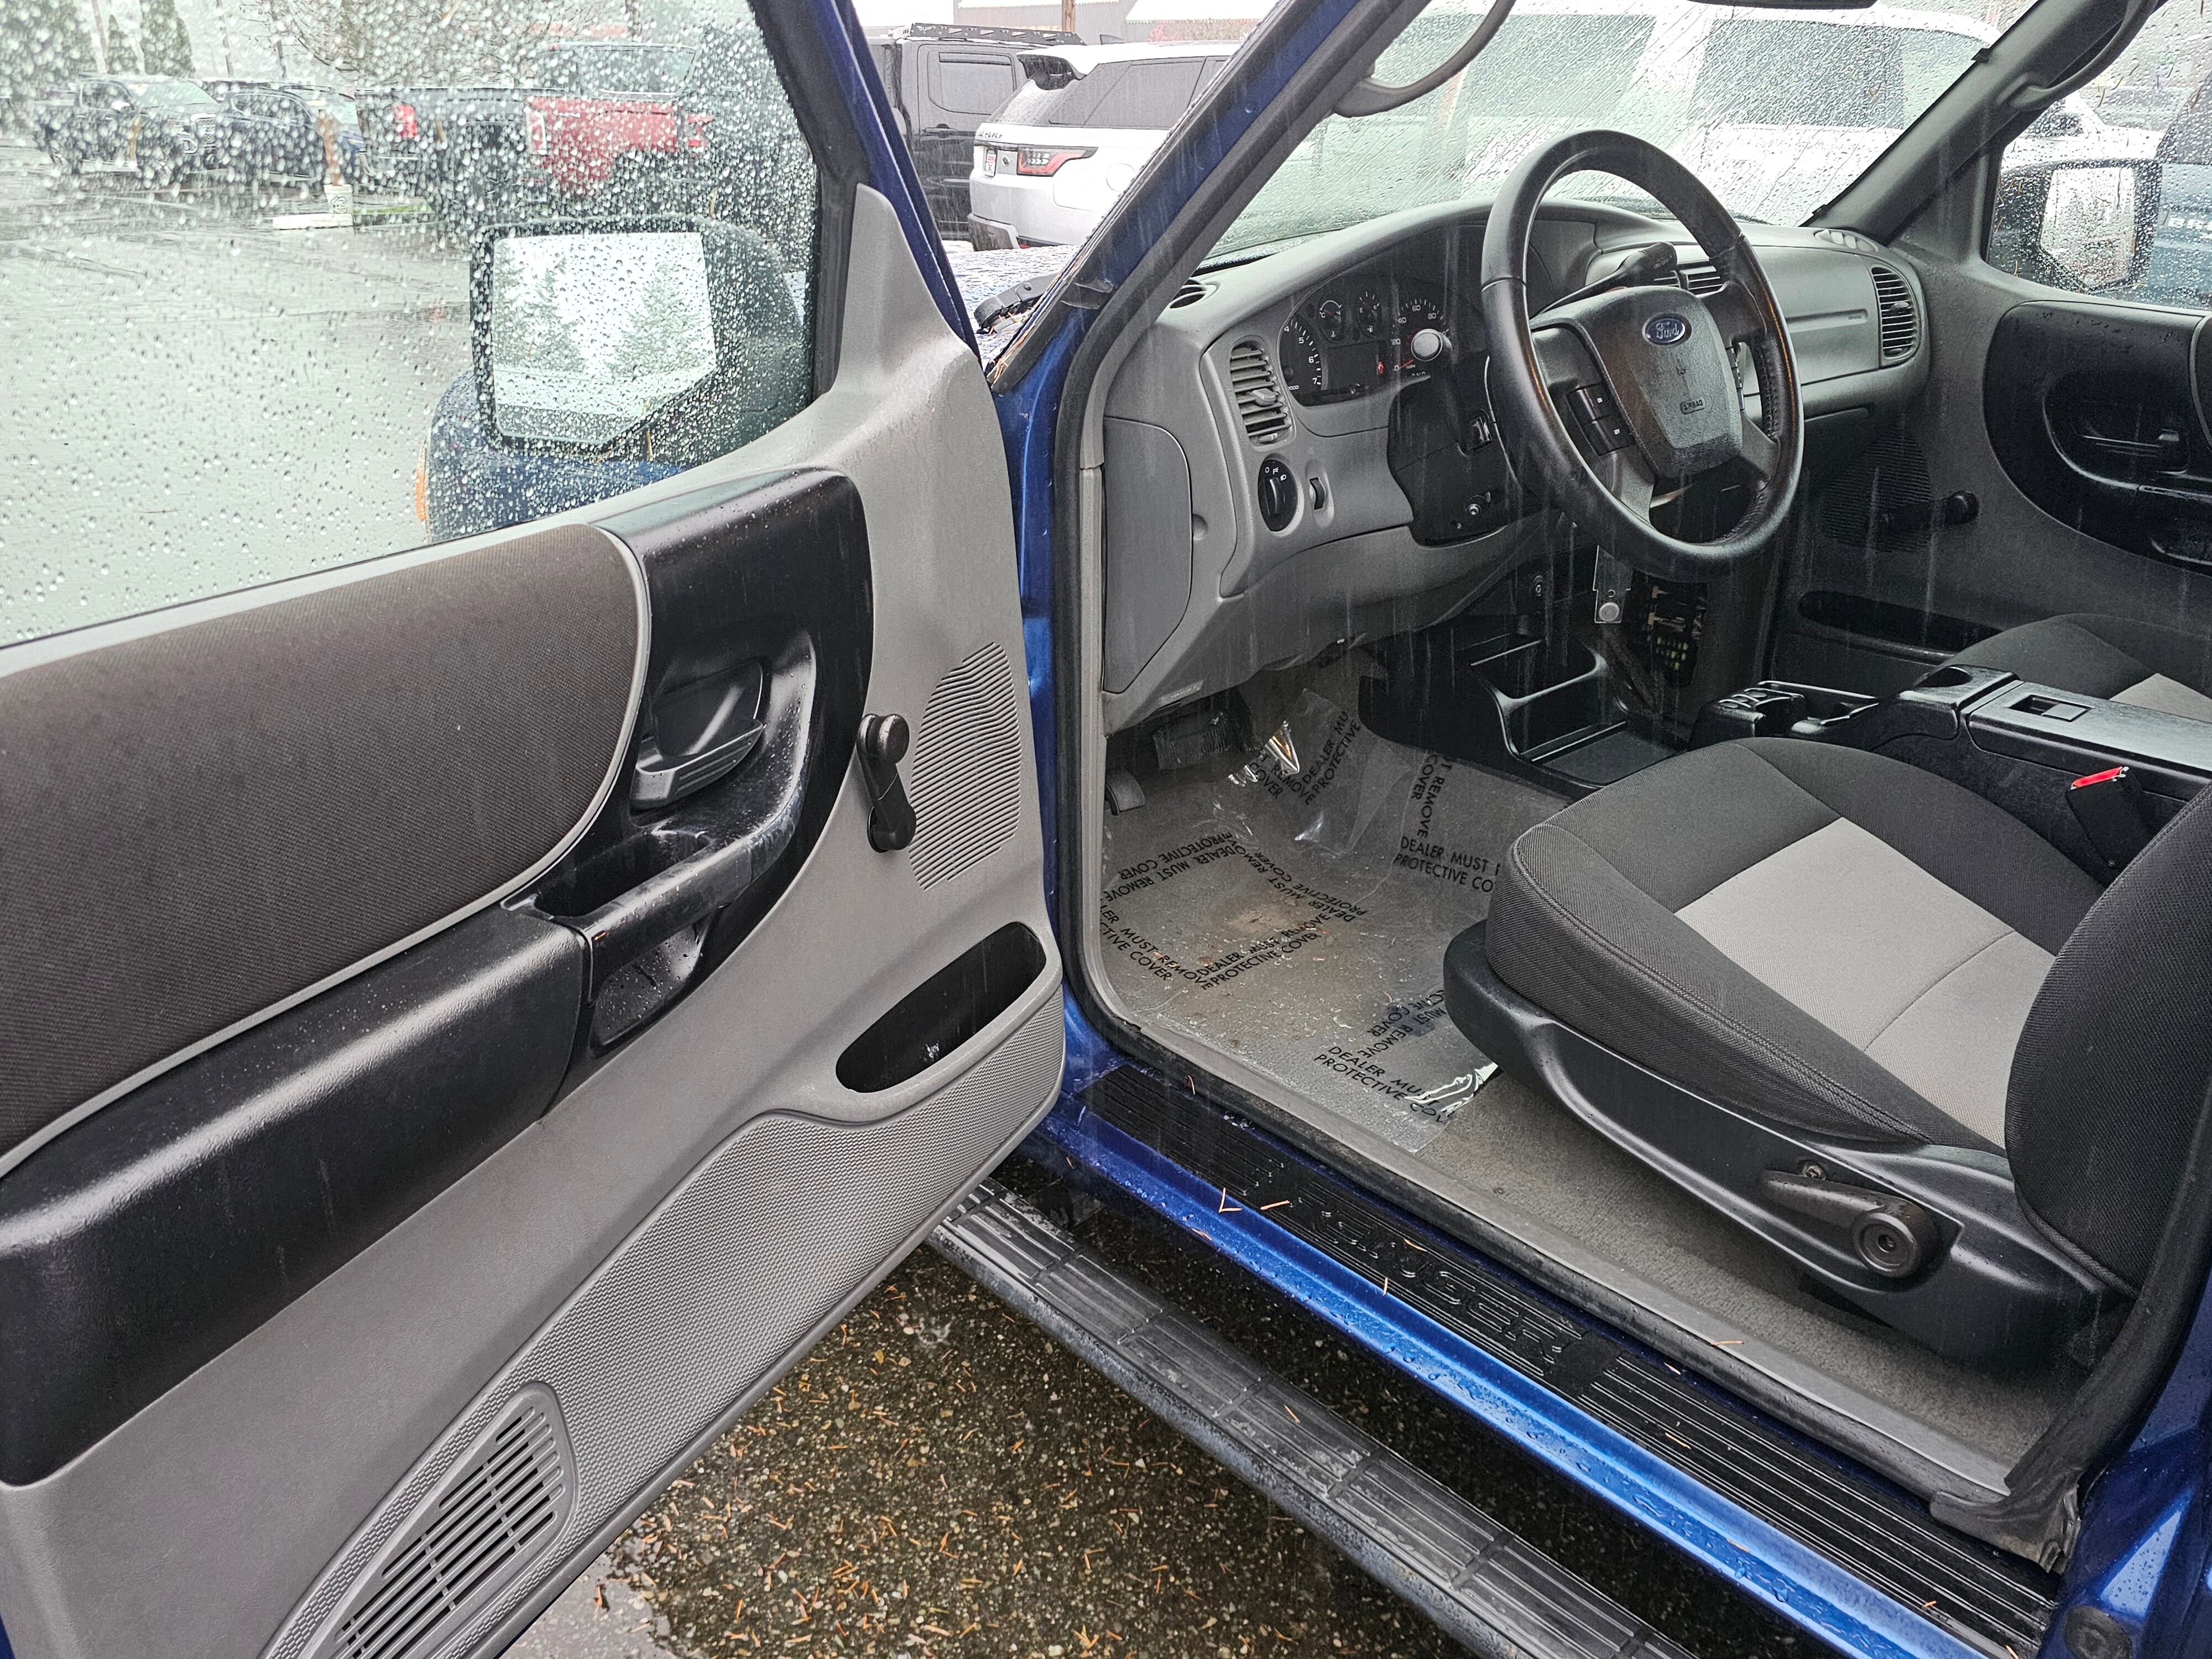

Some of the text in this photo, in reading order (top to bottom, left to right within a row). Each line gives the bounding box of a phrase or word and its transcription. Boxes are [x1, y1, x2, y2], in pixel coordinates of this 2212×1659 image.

[1656, 319, 1679, 338] Ford
[1683, 399, 1703, 411] AIRBAG
[1302, 739, 1335, 784] DEALER
[1312, 720, 1361, 794] PROTECTIVE
[1411, 753, 1438, 800] COVER
[1249, 762, 1284, 799] COVER
[1271, 764, 1316, 805] REMOVE
[1417, 776, 1445, 839] REMOVE
[1103, 845, 1237, 902] DEALER MUST REMOVE
[1118, 834, 1226, 880] PROTECTIVE COVER
[1392, 853, 1468, 885] PROTECTIVE
[1401, 835, 1444, 858] DEALER
[1450, 851, 1489, 873] MUST
[1223, 832, 1356, 923] DEALER MUST REMOVE
[1254, 852, 1368, 916] PROTECTIVE COVER
[1120, 927, 1159, 953] MUST
[1157, 955, 1214, 990] REMOVE
[1130, 951, 1172, 980] COVER
[1197, 912, 1331, 977] DEALER MUST REMOVE
[1210, 932, 1322, 985] PROTECTIVE COVER
[1357, 1007, 1448, 1058] MUST REMOVE
[1366, 1006, 1410, 1037] COVER
[1314, 1053, 1408, 1101] PROTECTIVE
[1328, 1046, 1386, 1077] DEALER
